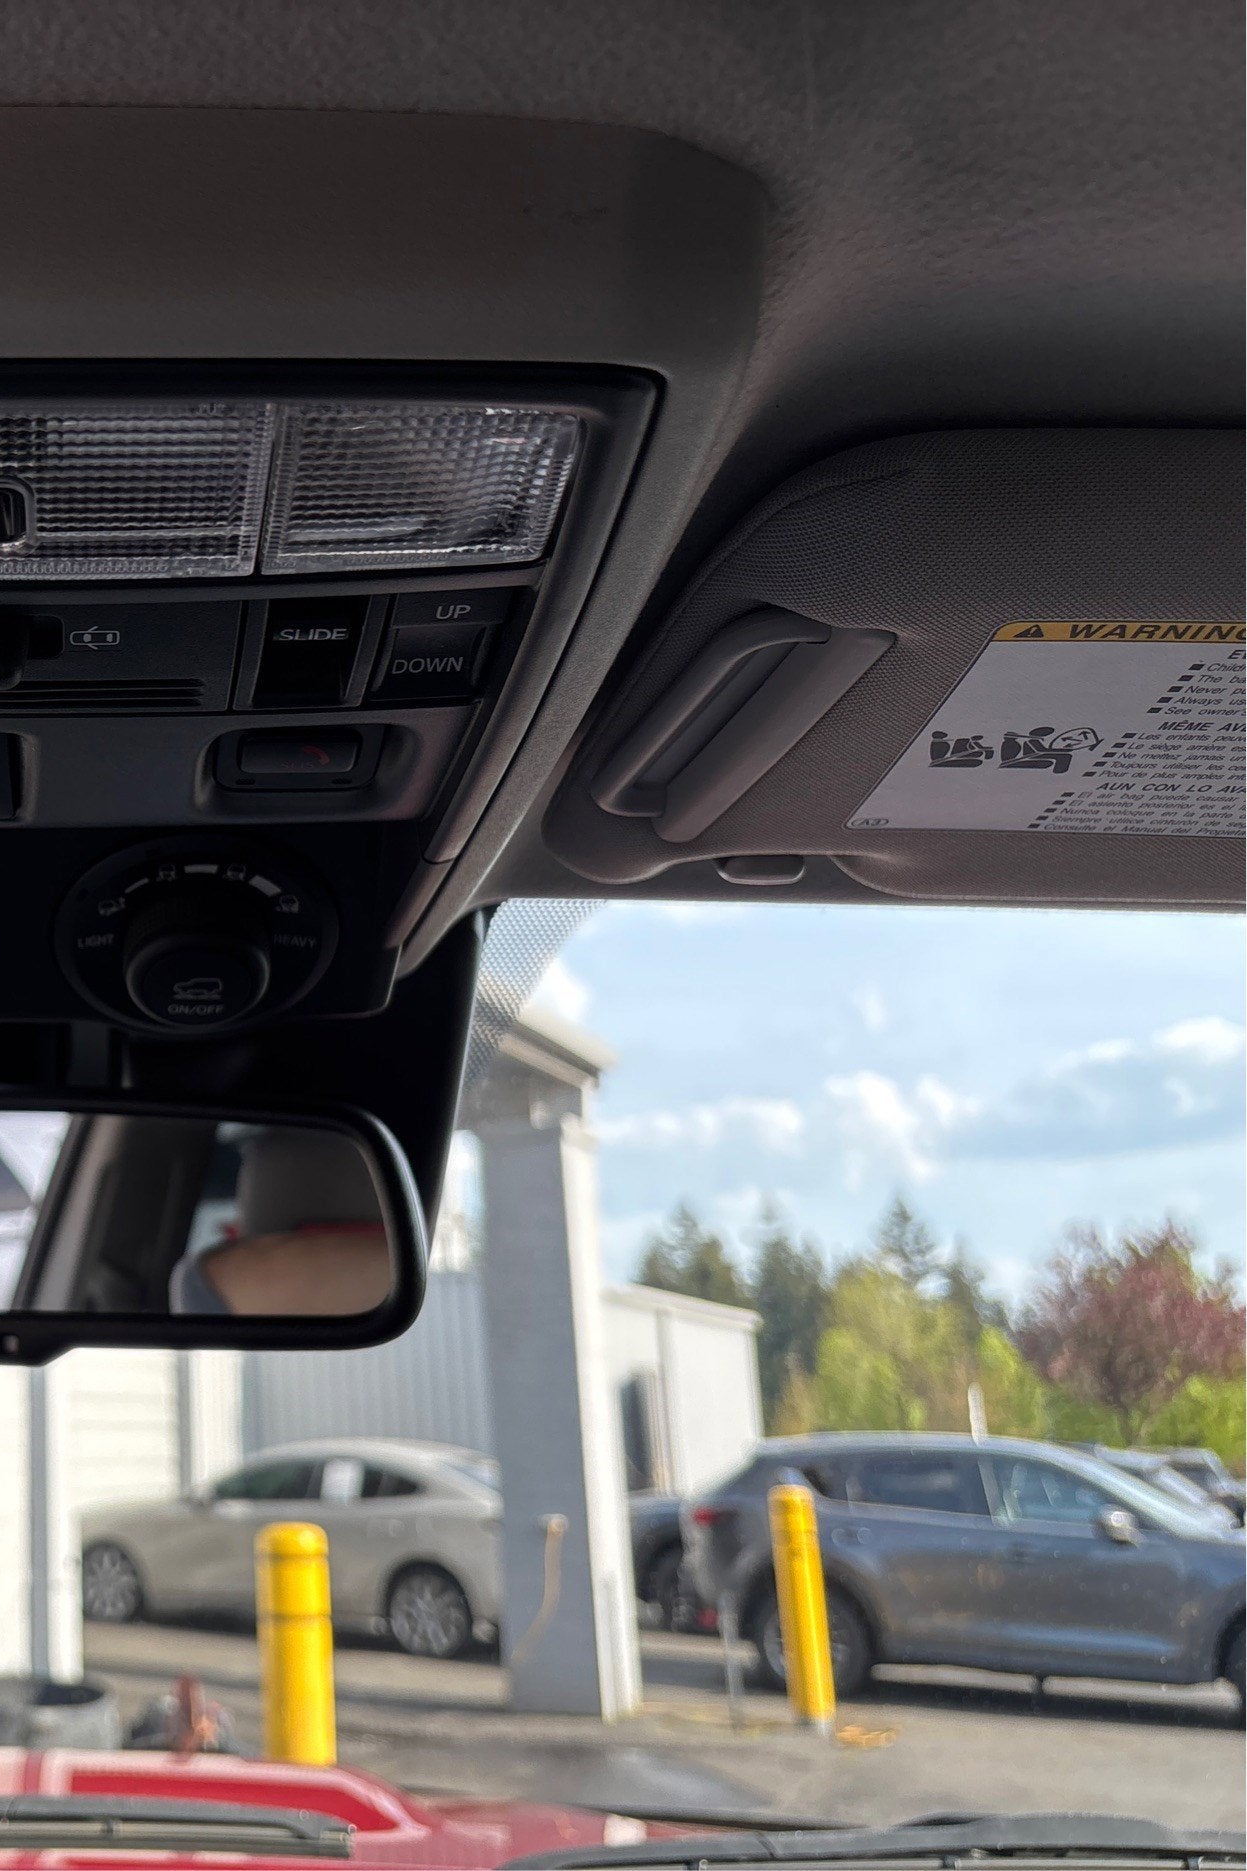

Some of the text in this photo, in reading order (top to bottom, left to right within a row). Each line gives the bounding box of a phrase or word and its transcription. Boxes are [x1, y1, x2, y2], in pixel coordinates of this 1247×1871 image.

[435, 604, 471, 620] UP
[277, 628, 350, 641] SLIDE
[391, 656, 464, 675] DOWN
[1197, 674, 1223, 683] The
[1184, 685, 1228, 694] Never
[1173, 696, 1224, 707] Always
[1164, 706, 1192, 715] See
[1157, 719, 1214, 731] MÊME
[1137, 732, 1161, 741] Les
[1165, 733, 1212, 742] enfants
[1127, 741, 1144, 750] Le
[1140, 753, 1182, 761] mettez
[1183, 753, 1226, 763] jamais
[1110, 761, 1157, 770] Toujours
[1162, 762, 1202, 770] utiliser
[1205, 763, 1226, 771] les
[1098, 770, 1129, 778] Pour
[1131, 771, 1148, 779] de
[1150, 771, 1178, 780] plus
[1181, 772, 1226, 781] amples
[1096, 782, 1136, 791] AUN
[1142, 783, 1182, 792] CON
[1185, 784, 1213, 793] LO
[1096, 792, 1115, 800] air
[1119, 792, 1145, 801] bag
[1147, 793, 1191, 803] puede
[1138, 801, 1195, 810] posterior
[1221, 803, 1237, 811] el
[1106, 809, 1155, 818] coloque
[1198, 812, 1234, 820] parte
[1120, 826, 1167, 834] Manual
[1170, 827, 1193, 835] del
[77, 933, 115, 949] LIGHT
[273, 933, 317, 949] HEAVY
[167, 1004, 225, 1016] ON/OFF
